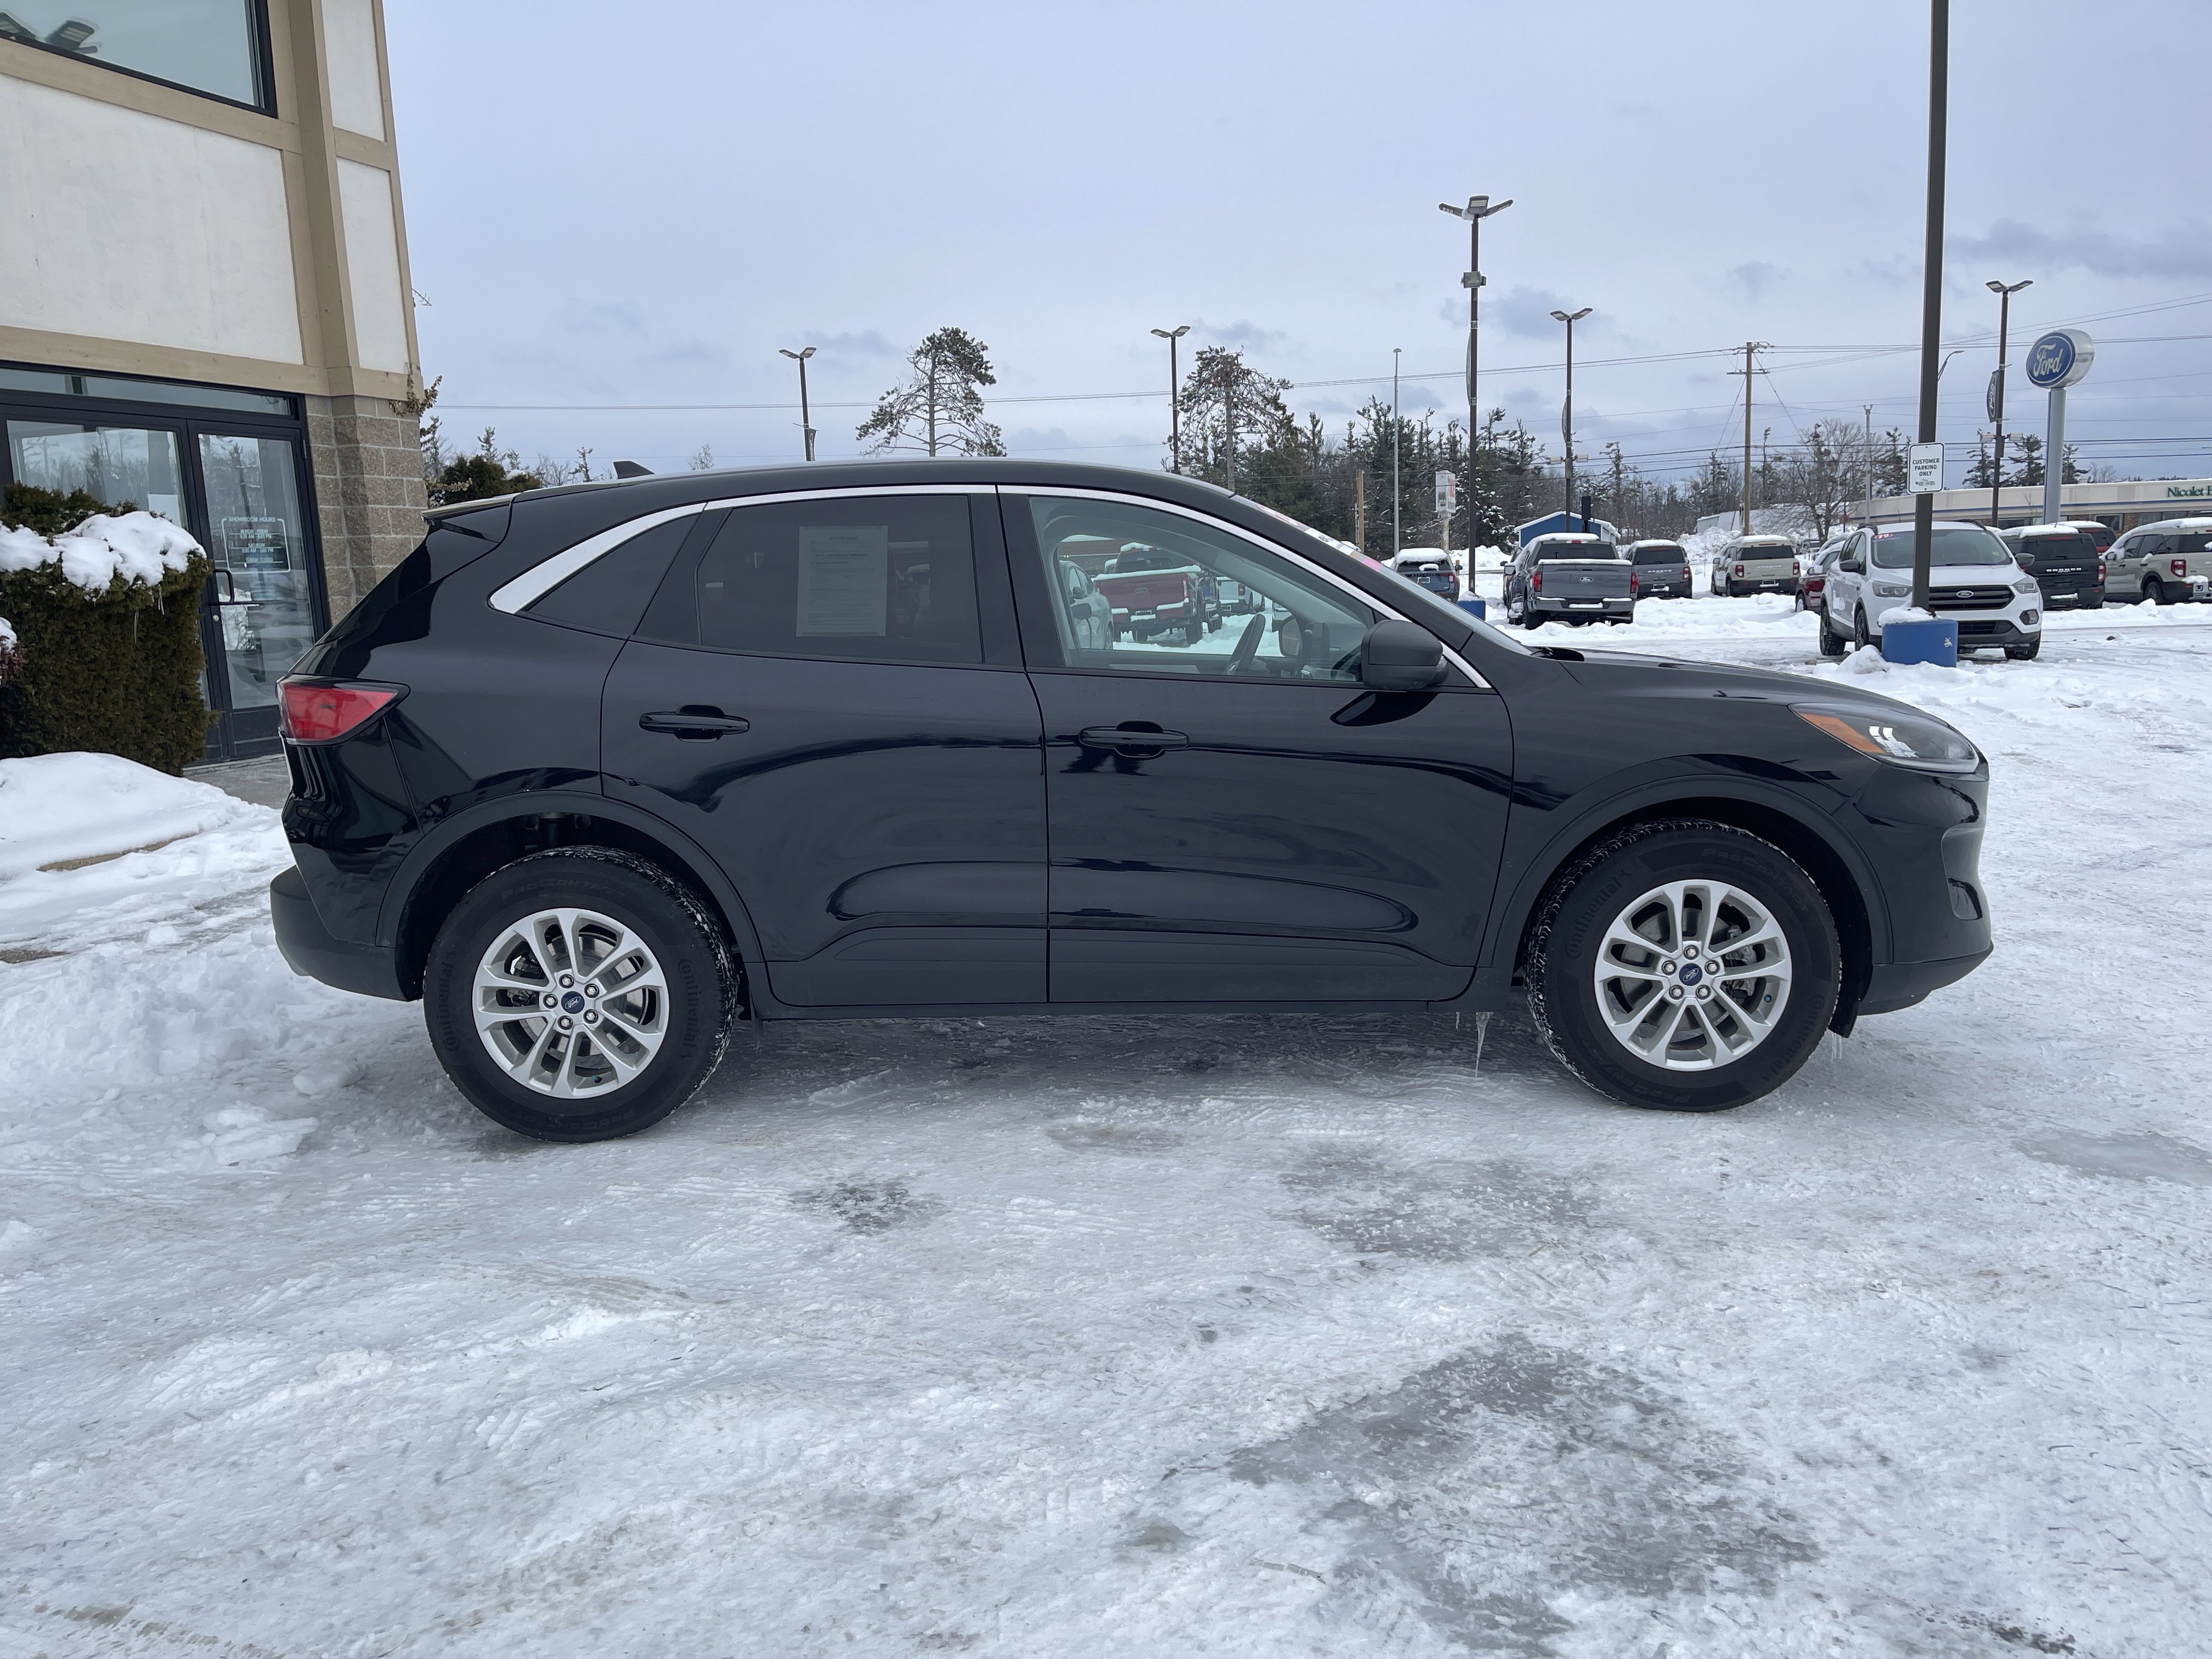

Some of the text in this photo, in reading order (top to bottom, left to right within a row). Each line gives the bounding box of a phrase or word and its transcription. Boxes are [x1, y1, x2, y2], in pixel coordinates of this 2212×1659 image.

[2033, 343, 2064, 377] Ford
[2168, 486, 2204, 497] Nicolet
[1565, 876, 1623, 960] Continental
[437, 961, 461, 1052] Continental
[677, 958, 702, 1048] Continental
